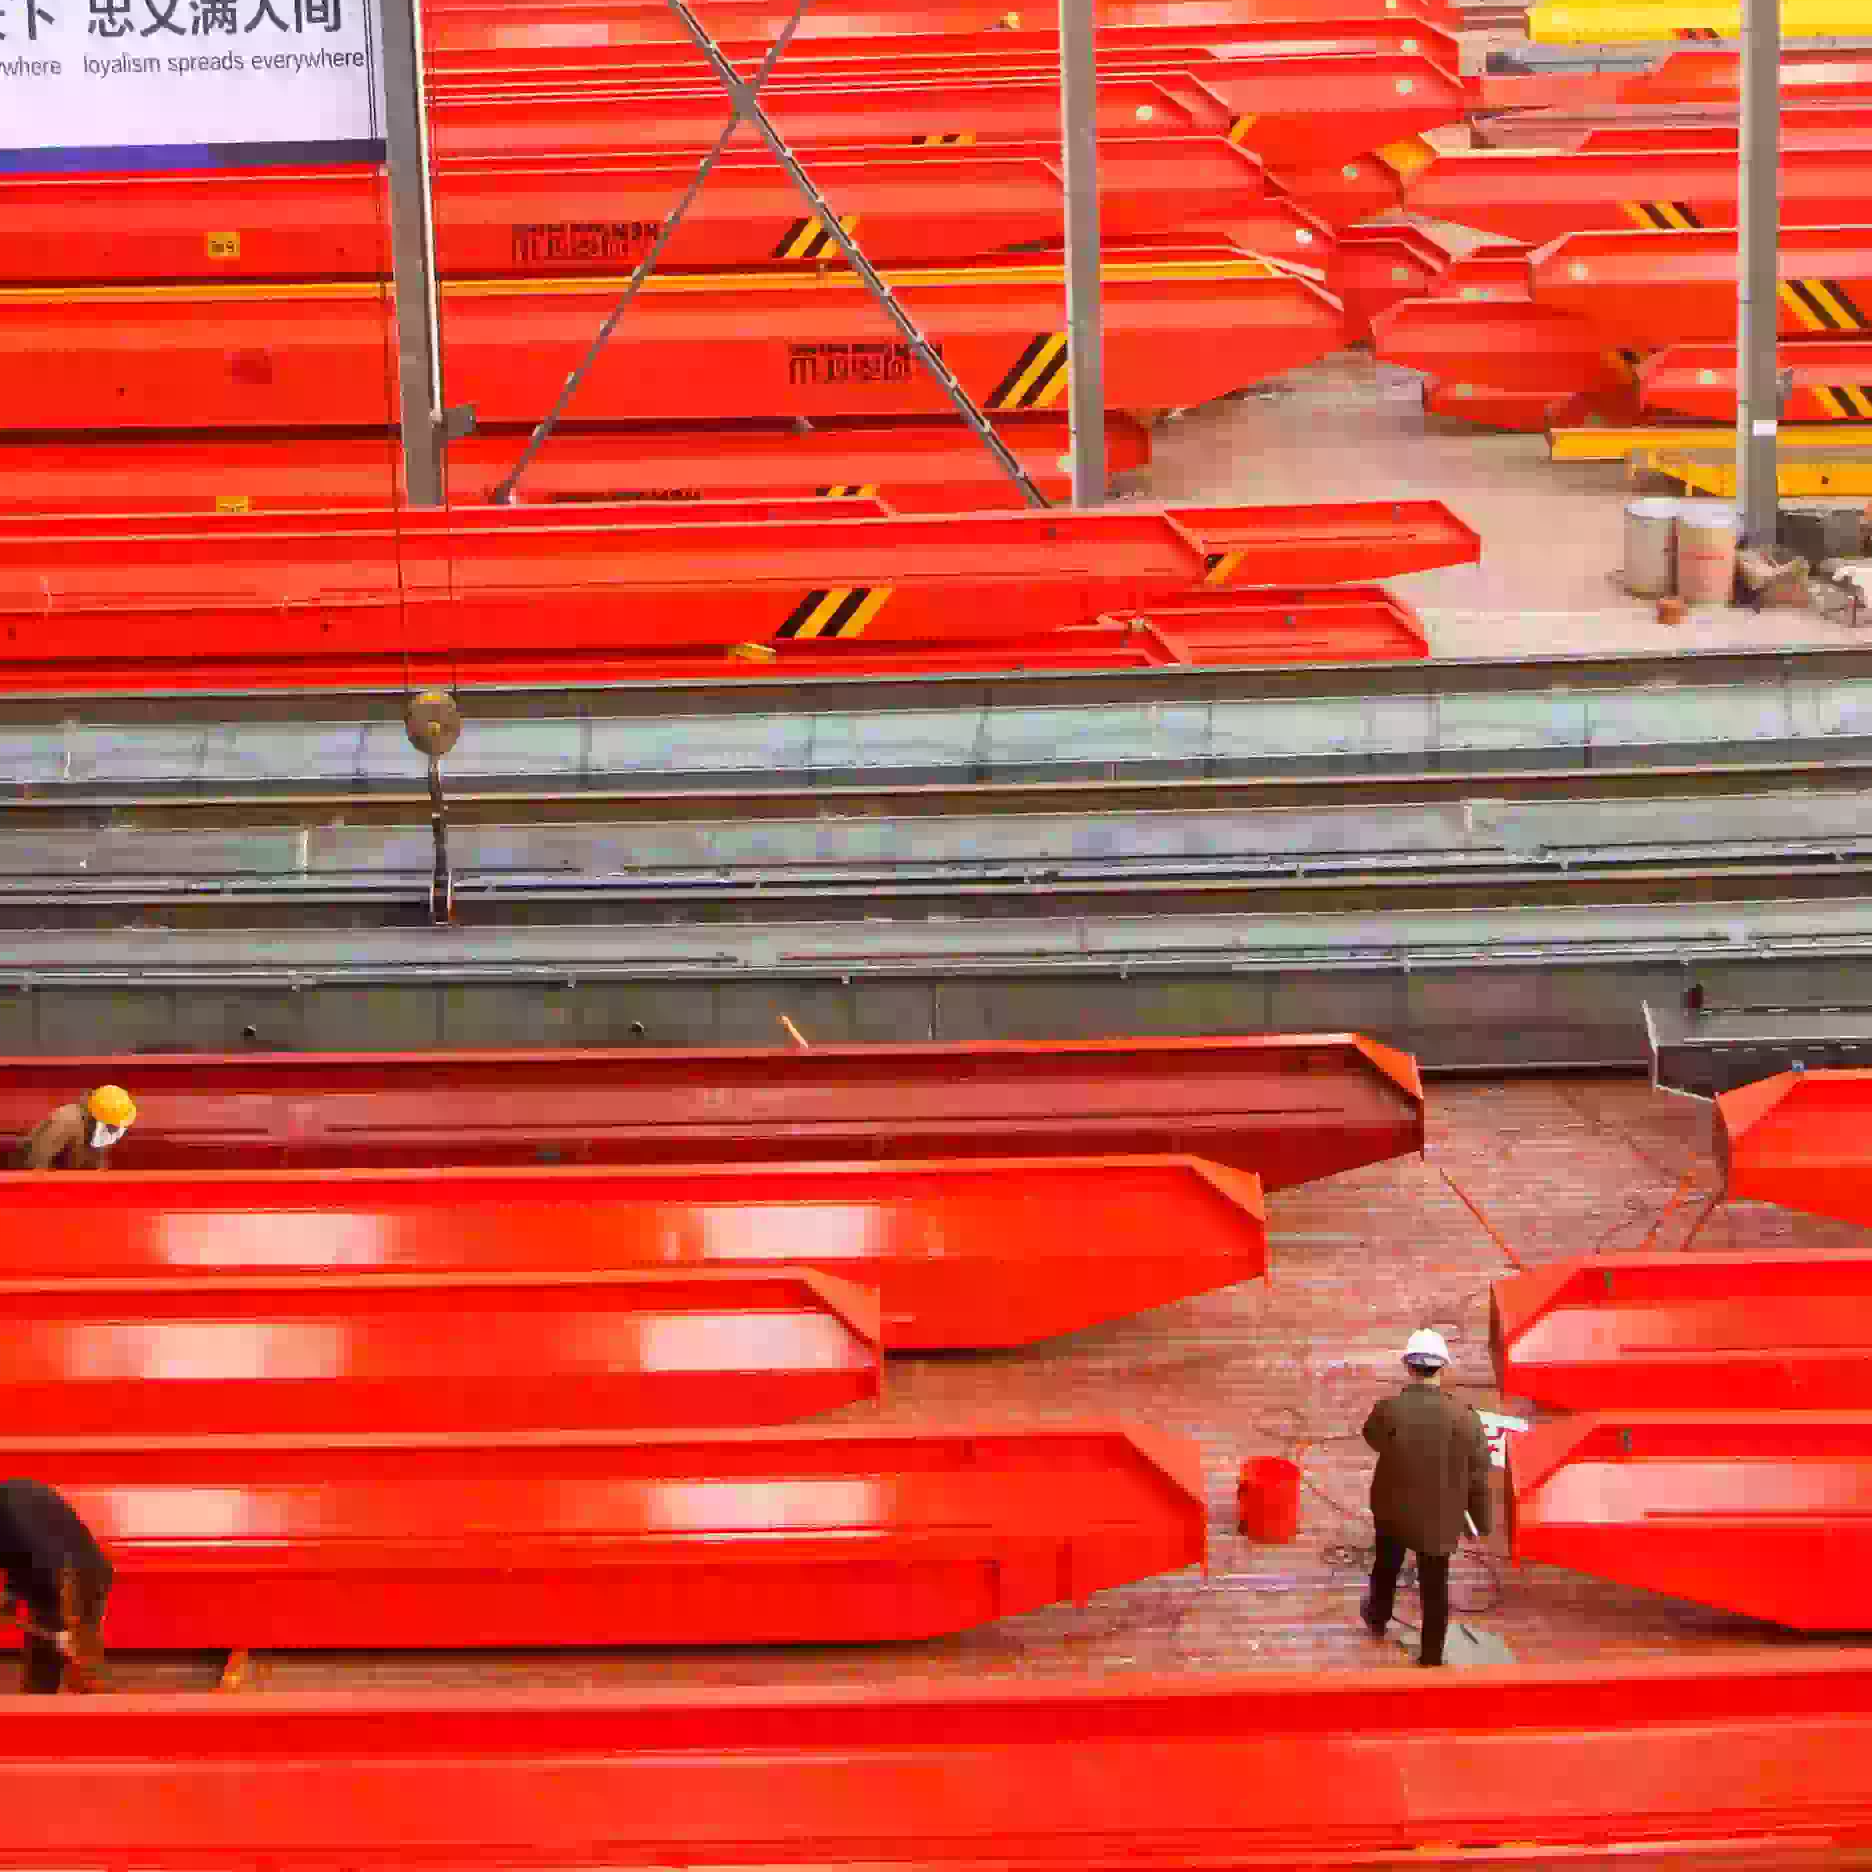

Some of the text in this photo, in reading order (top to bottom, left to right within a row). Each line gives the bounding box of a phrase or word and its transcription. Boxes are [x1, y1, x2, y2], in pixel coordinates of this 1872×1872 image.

[83, 50, 162, 80] loyalism
[167, 49, 245, 77] spreads
[251, 46, 365, 75] everywhere
